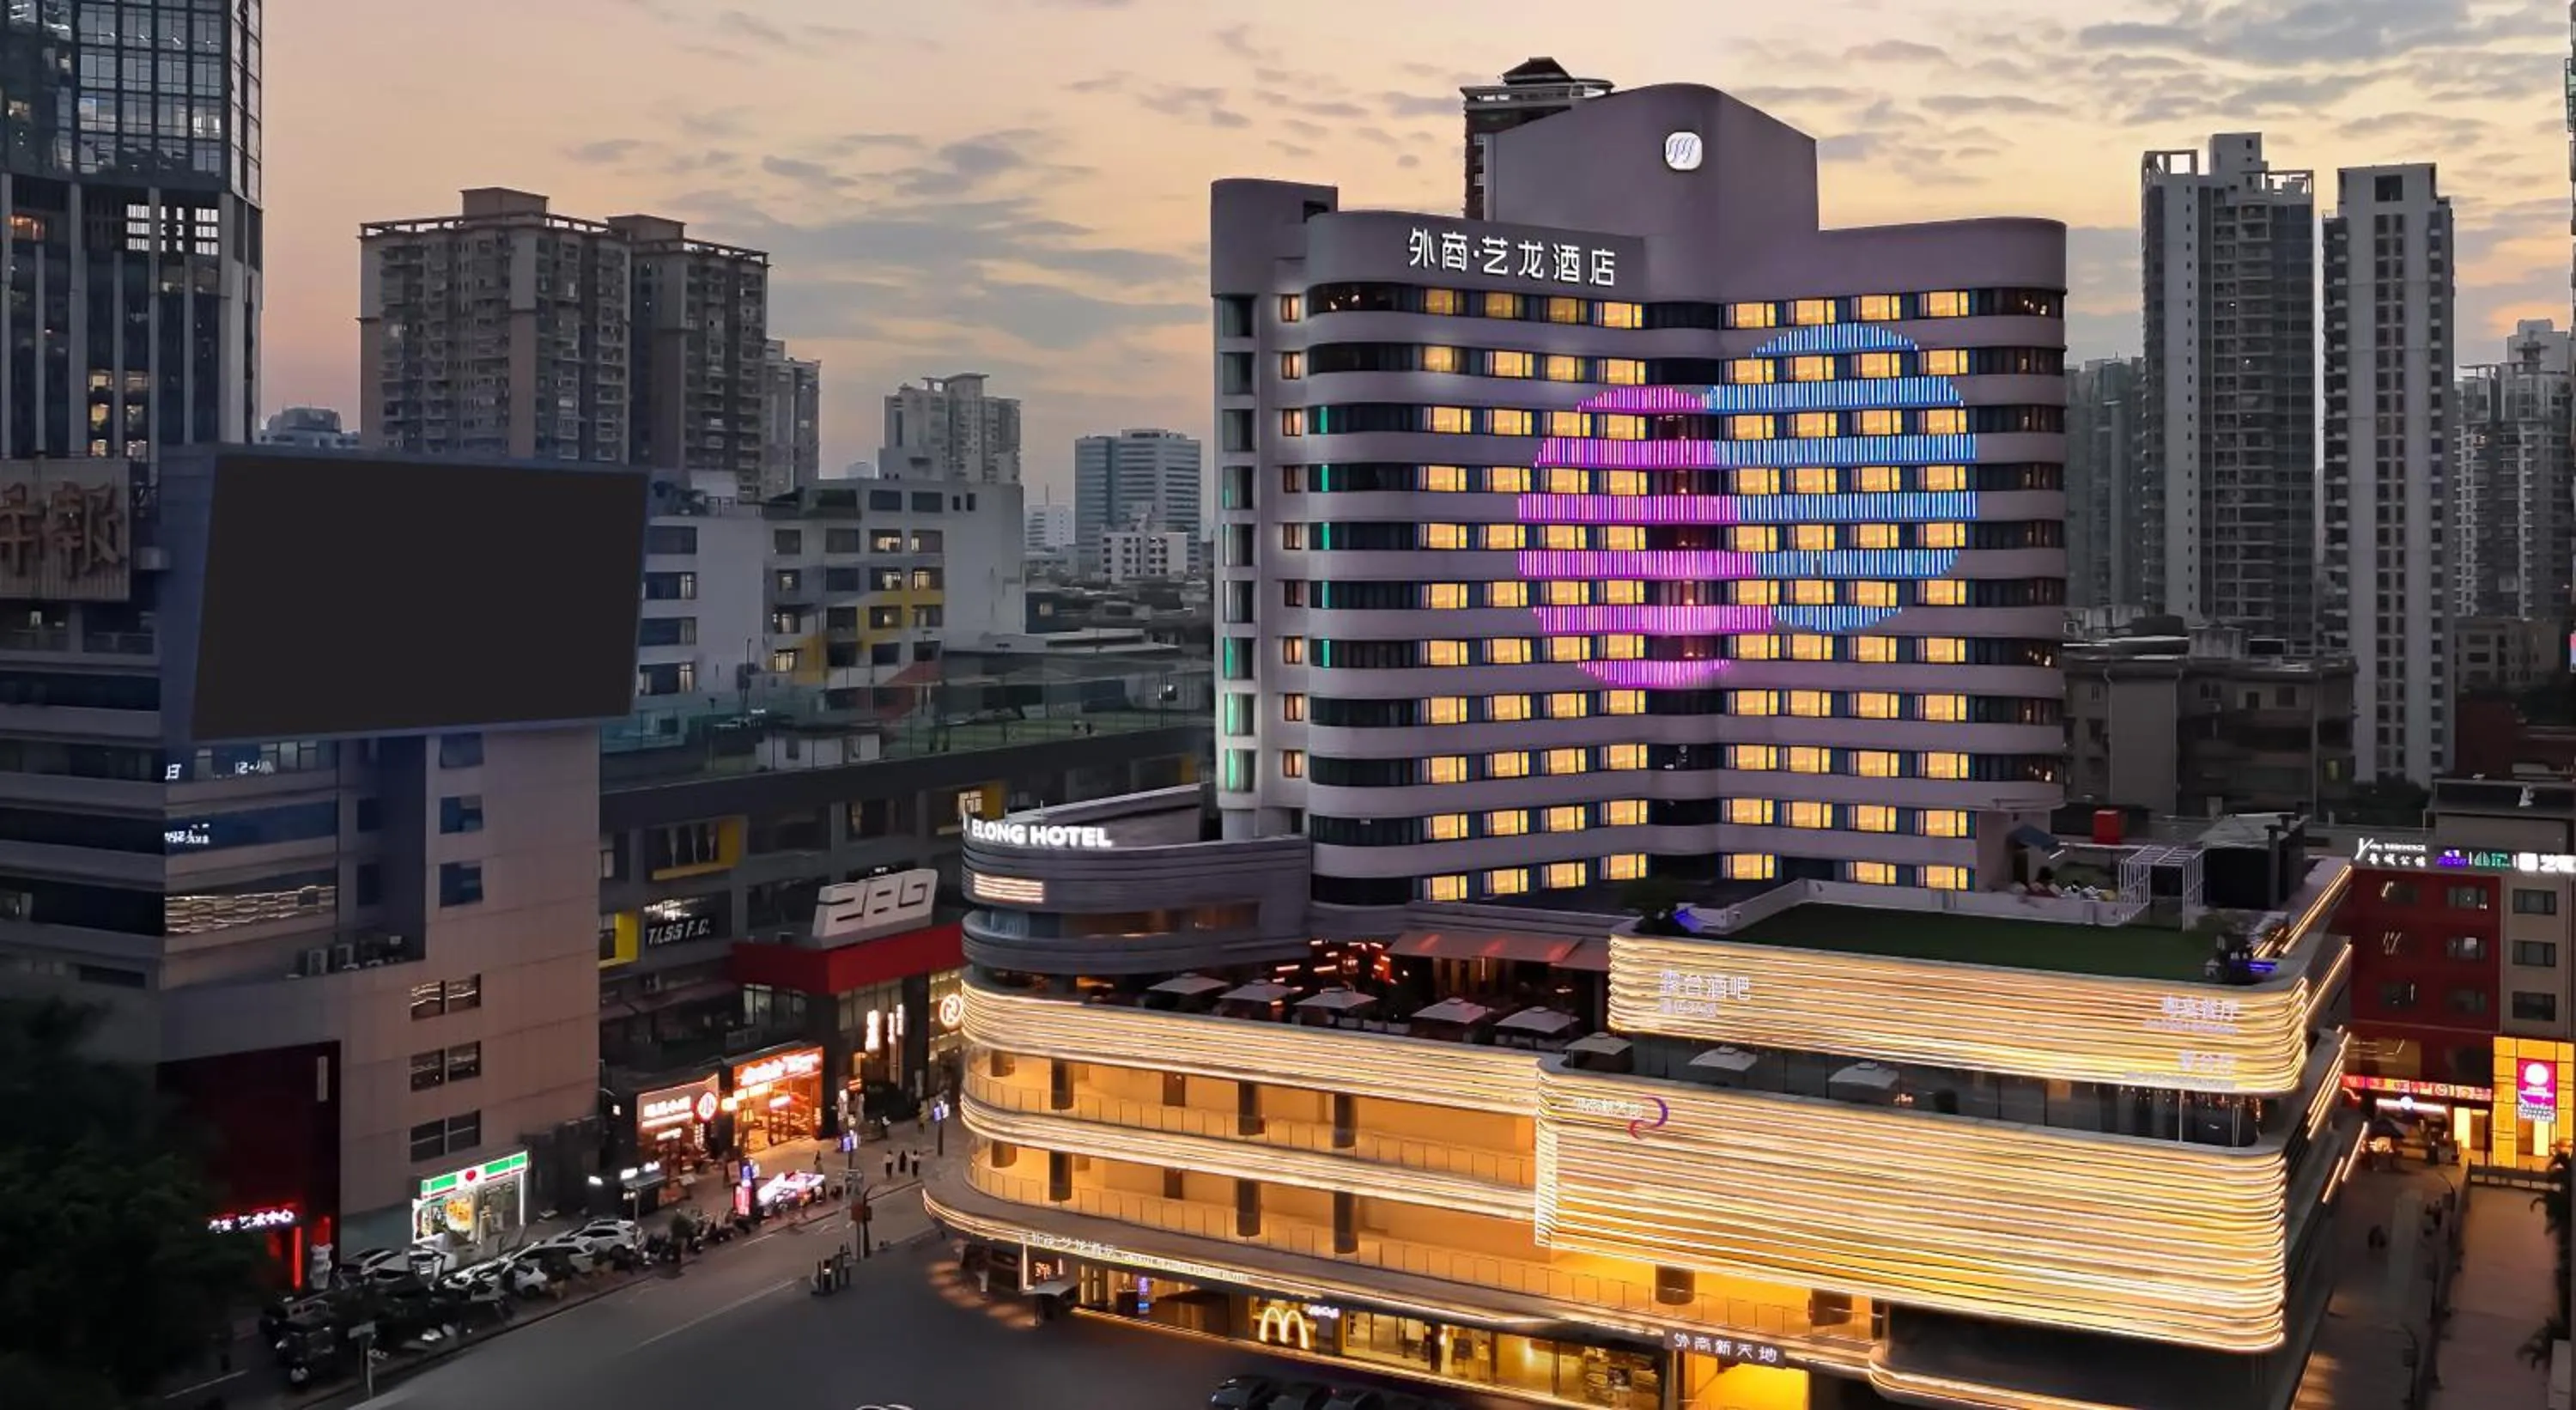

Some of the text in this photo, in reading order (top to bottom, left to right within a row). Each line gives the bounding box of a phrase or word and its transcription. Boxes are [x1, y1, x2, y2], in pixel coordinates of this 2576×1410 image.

[1408, 227, 1616, 287] 外商·艺龙酒店
[971, 817, 1114, 848] ELONG HOTEL
[1674, 1332, 1777, 1364] 外商新天地
